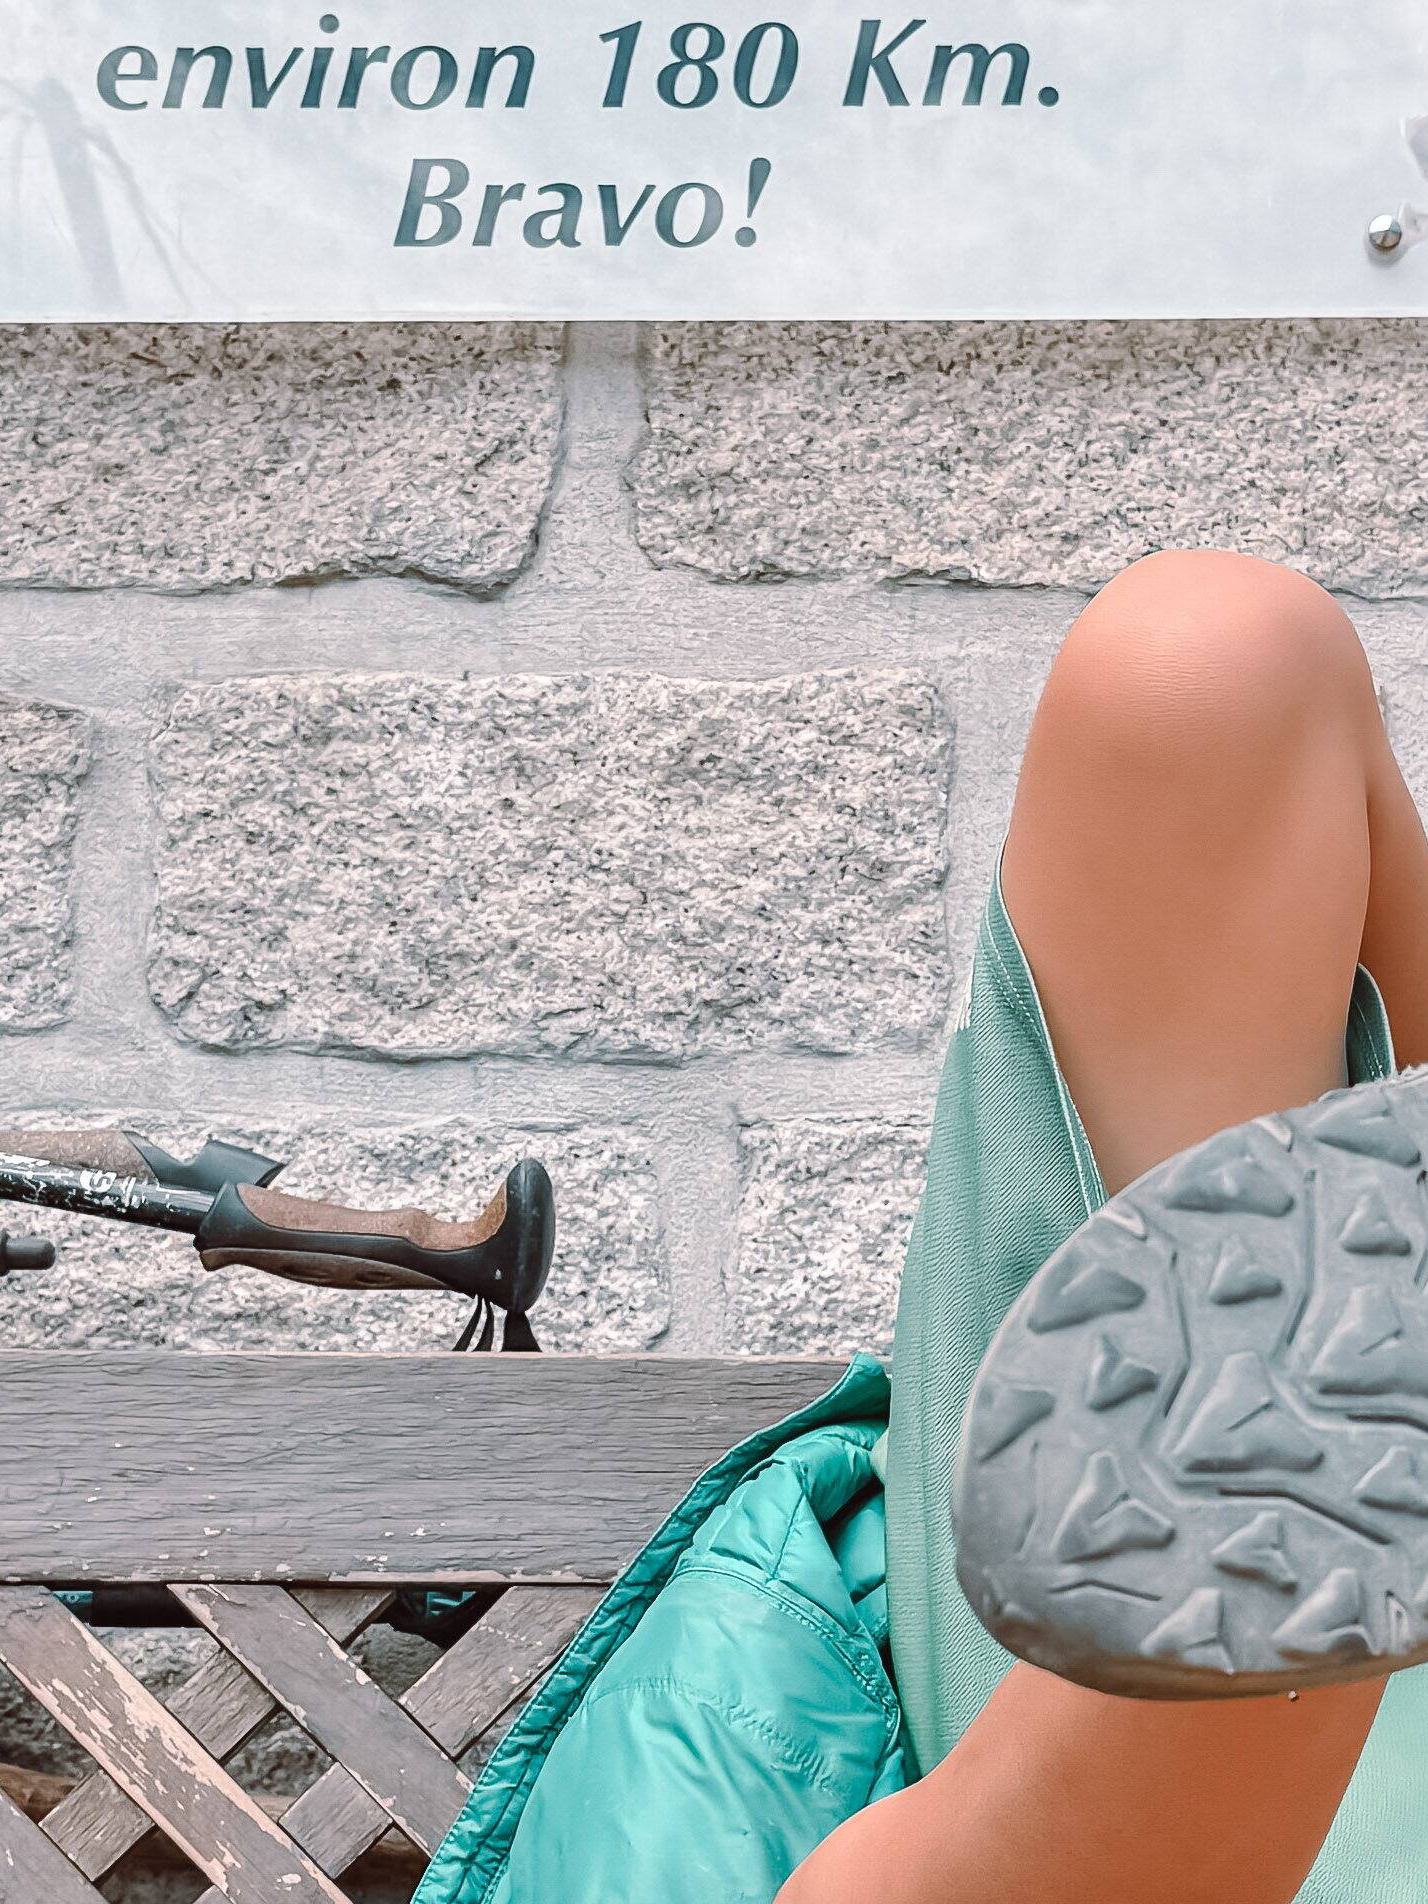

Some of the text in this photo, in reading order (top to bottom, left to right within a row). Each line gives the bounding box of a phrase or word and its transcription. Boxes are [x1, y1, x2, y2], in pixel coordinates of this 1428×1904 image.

[97, 14, 1059, 110] environ 180 Km.
[394, 158, 771, 248] Bravo!
